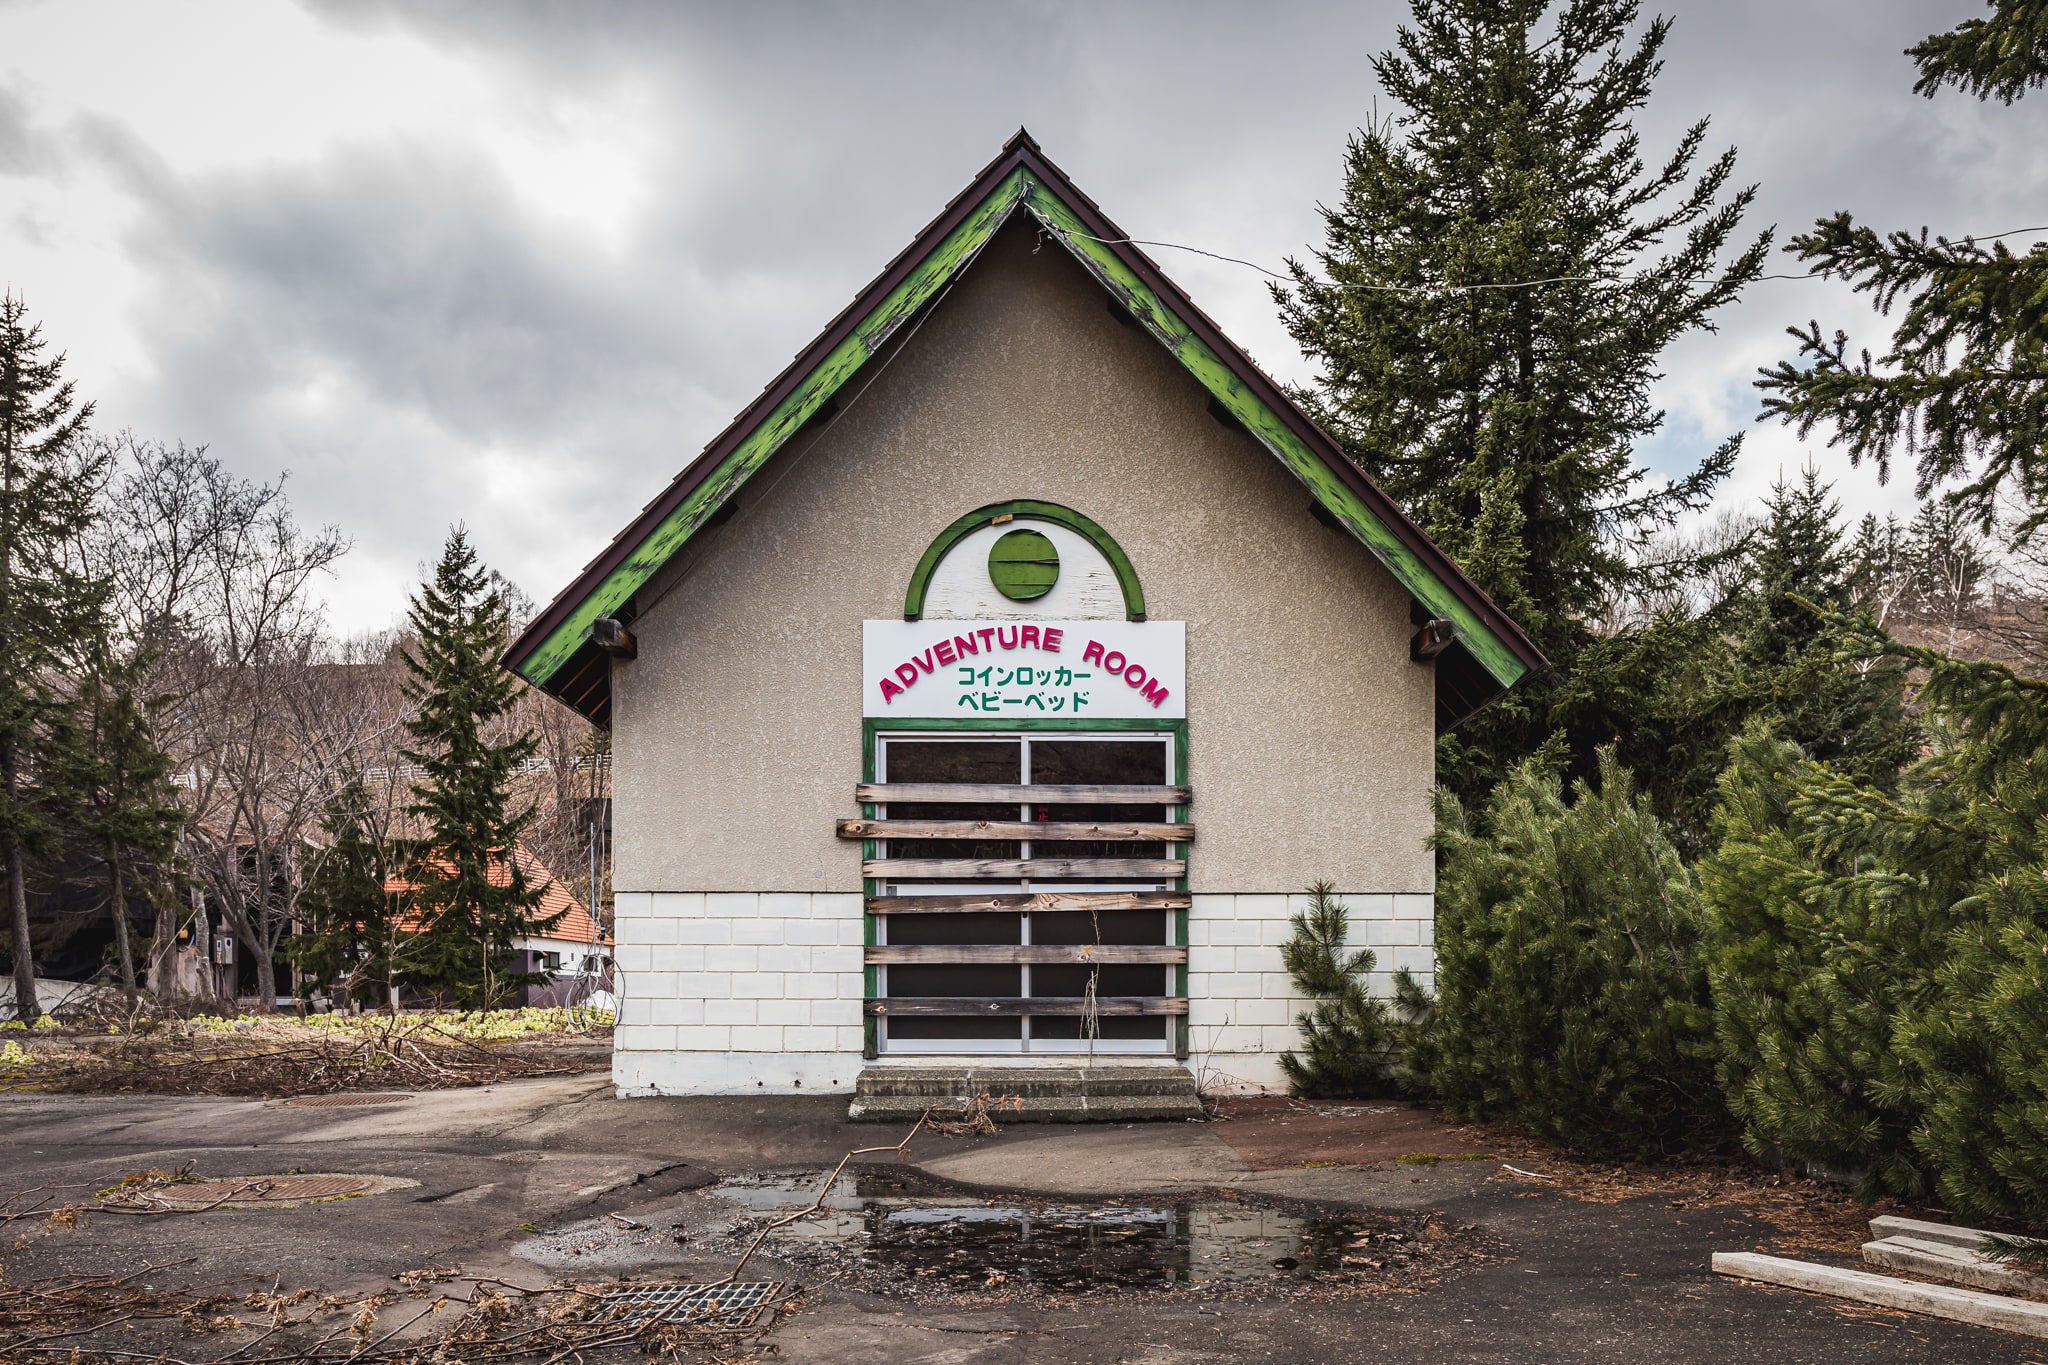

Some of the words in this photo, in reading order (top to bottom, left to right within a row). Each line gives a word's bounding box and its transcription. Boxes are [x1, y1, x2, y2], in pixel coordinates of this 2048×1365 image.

[879, 624, 1064, 703] ADVENTURE
[1082, 639, 1170, 708] ROOM
[958, 665, 1092, 687] コインロッカー
[958, 691, 1089, 713] ベビーベッド
